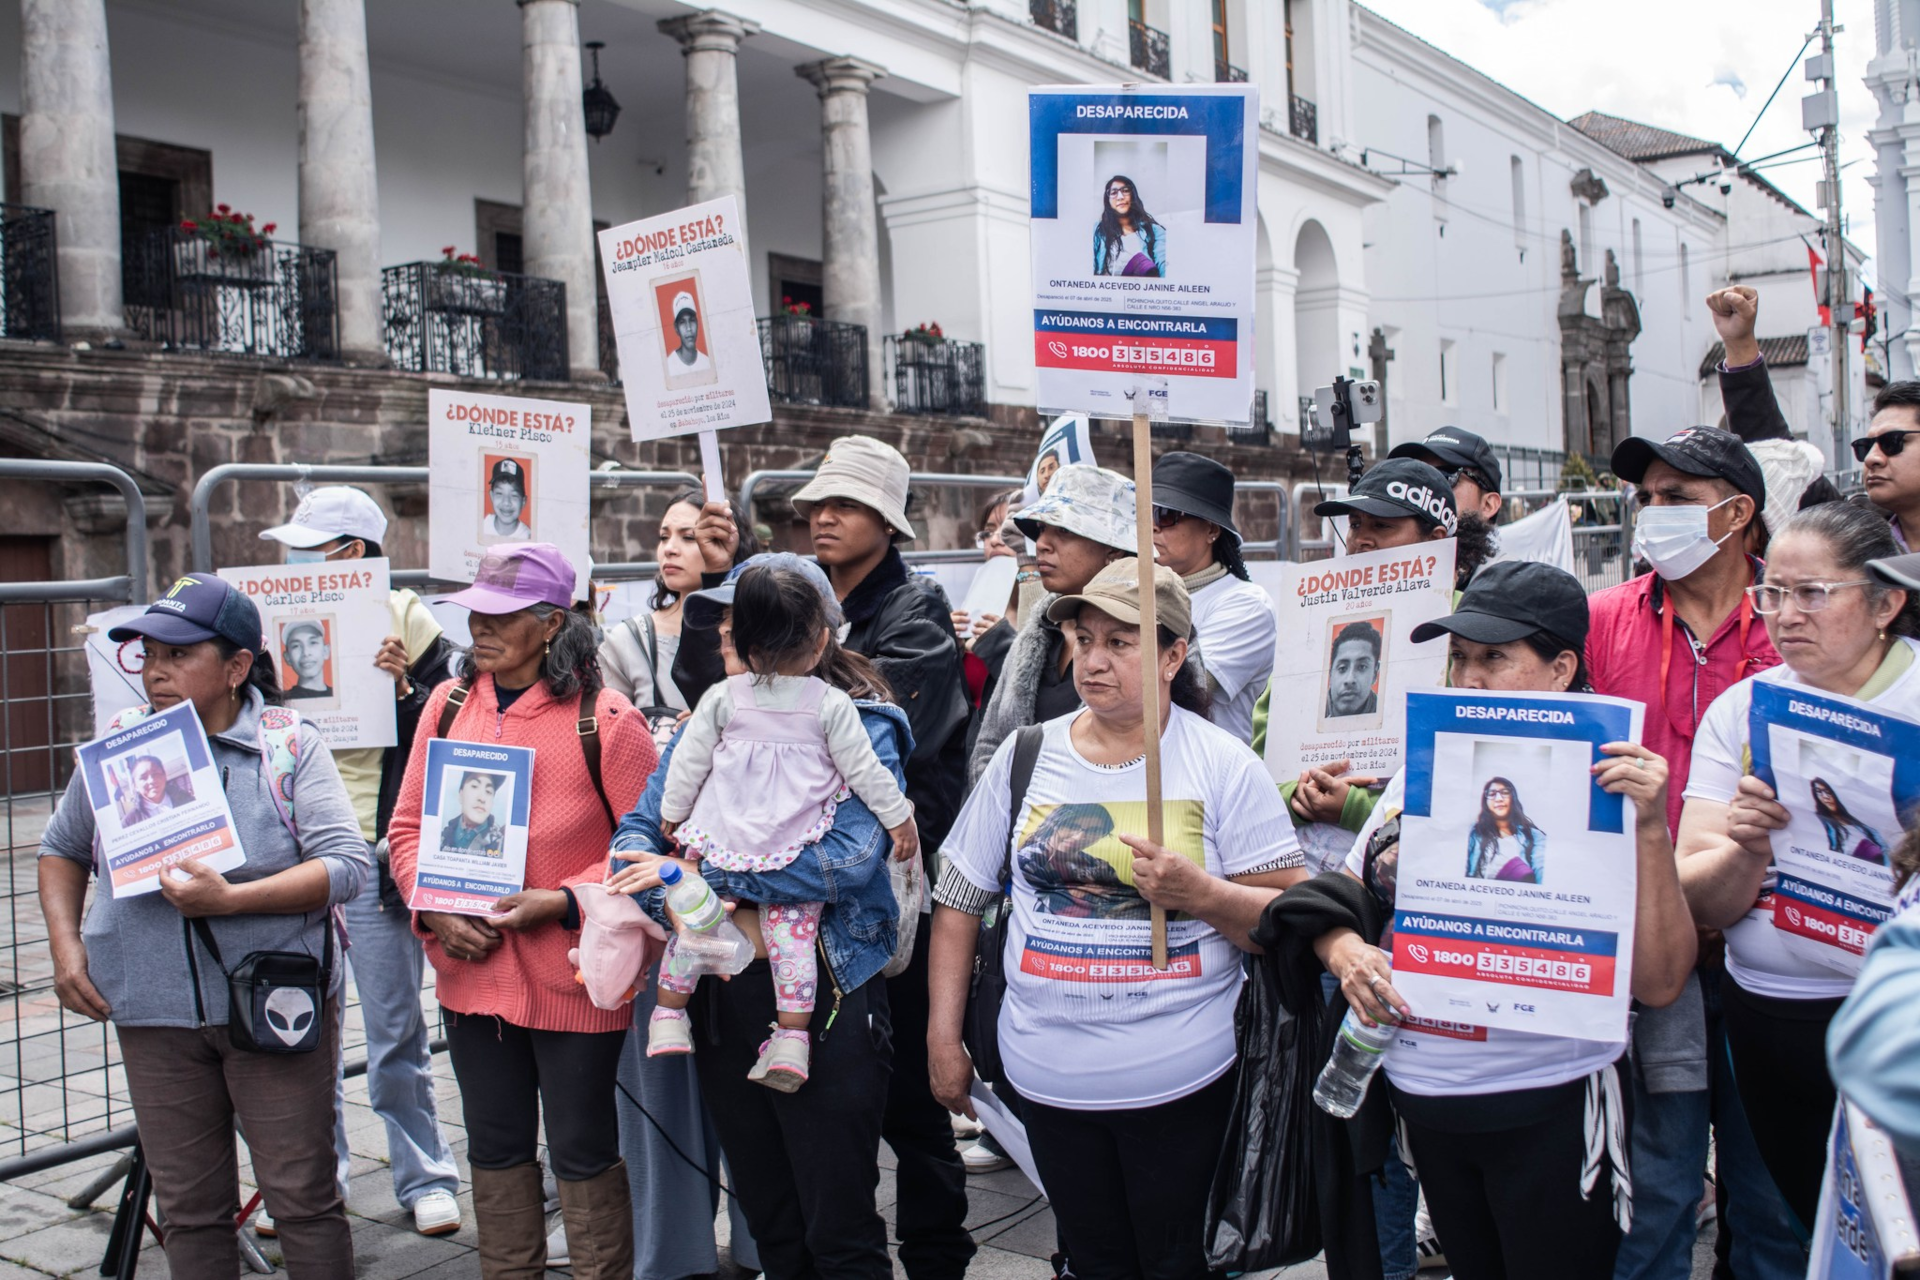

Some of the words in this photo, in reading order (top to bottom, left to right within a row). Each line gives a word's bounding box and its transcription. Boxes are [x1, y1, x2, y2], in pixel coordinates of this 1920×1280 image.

[1076, 105, 1189, 119] DESAPARECIDA
[616, 228, 677, 261] ¿DÓNDE
[679, 214, 724, 244] ESTÁ?
[612, 255, 652, 274] Jeampier
[654, 248, 685, 263] Maicol
[1049, 280, 1097, 289] ONTANEDA
[1099, 281, 1141, 291] ACEVEDO
[1143, 283, 1175, 292] JANINE
[1177, 285, 1211, 293] AILEEN
[1041, 314, 1104, 328] AYÚDANOS
[1107, 319, 1116, 329] A
[1117, 319, 1207, 333] ENCONTRARLA
[1071, 346, 1109, 358] 1800
[1148, 365, 1215, 373] CONFIDENCIALIDAD
[446, 403, 519, 427] ¿DÓNDE
[523, 412, 575, 433] ESTÁ?
[468, 422, 516, 439] Kleiner
[520, 427, 552, 443] Pisco
[1685, 440, 1711, 457] FILA
[318, 570, 373, 591] ESTÁ?
[1297, 566, 1373, 597] ¿DÓNDE
[1378, 555, 1437, 584] ESTÁ?
[264, 593, 307, 606] Carlos
[310, 591, 345, 603] Pisco
[1341, 584, 1393, 600] Valverde
[1345, 602, 1355, 610] 20
[1455, 705, 1575, 725] DESAPARECIDA
[1788, 700, 1881, 737] DESAPARECIDA
[105, 719, 168, 749] DESAPARECIDO
[1300, 740, 1346, 751] desaparecido
[1348, 739, 1360, 749] por
[1361, 736, 1400, 746] militares
[453, 747, 509, 762] DESAPARECIDO
[1301, 755, 1309, 763] el
[1310, 754, 1319, 762] 25
[1320, 753, 1329, 761] de
[1330, 750, 1368, 760] noviembre
[1369, 750, 1377, 758] de
[1379, 748, 1397, 757] 2024
[1356, 762, 1368, 770] los
[163, 822, 216, 846] ENCONTRARLO
[138, 861, 162, 874] 1800
[1790, 846, 1830, 863] ONTANEDA
[1832, 856, 1868, 874] ACEVEDO
[423, 876, 456, 888] AYÚDANOS
[464, 882, 511, 894] ENCONTRARLO
[1416, 879, 1467, 892] ONTANEDA
[1469, 884, 1515, 896] ACEVEDO
[1517, 889, 1552, 900] JANINE
[1554, 892, 1591, 904] AILEEN
[434, 896, 454, 906] 1800
[1781, 879, 1834, 906] AYÚDANOS
[1834, 897, 1842, 908] A
[1844, 899, 1889, 921] ENCONT
[1042, 918, 1080, 928] ONTANEDA
[1082, 923, 1124, 931] ACEVEDO
[1402, 916, 1471, 934] AYÚDANOS
[1473, 924, 1484, 935] A
[1486, 925, 1584, 947] ENCONTRARLA
[1803, 915, 1837, 936] 1800
[1030, 938, 1083, 954] AYÚDANOS
[1433, 950, 1475, 966] 1800
[1049, 963, 1086, 974] 1800
